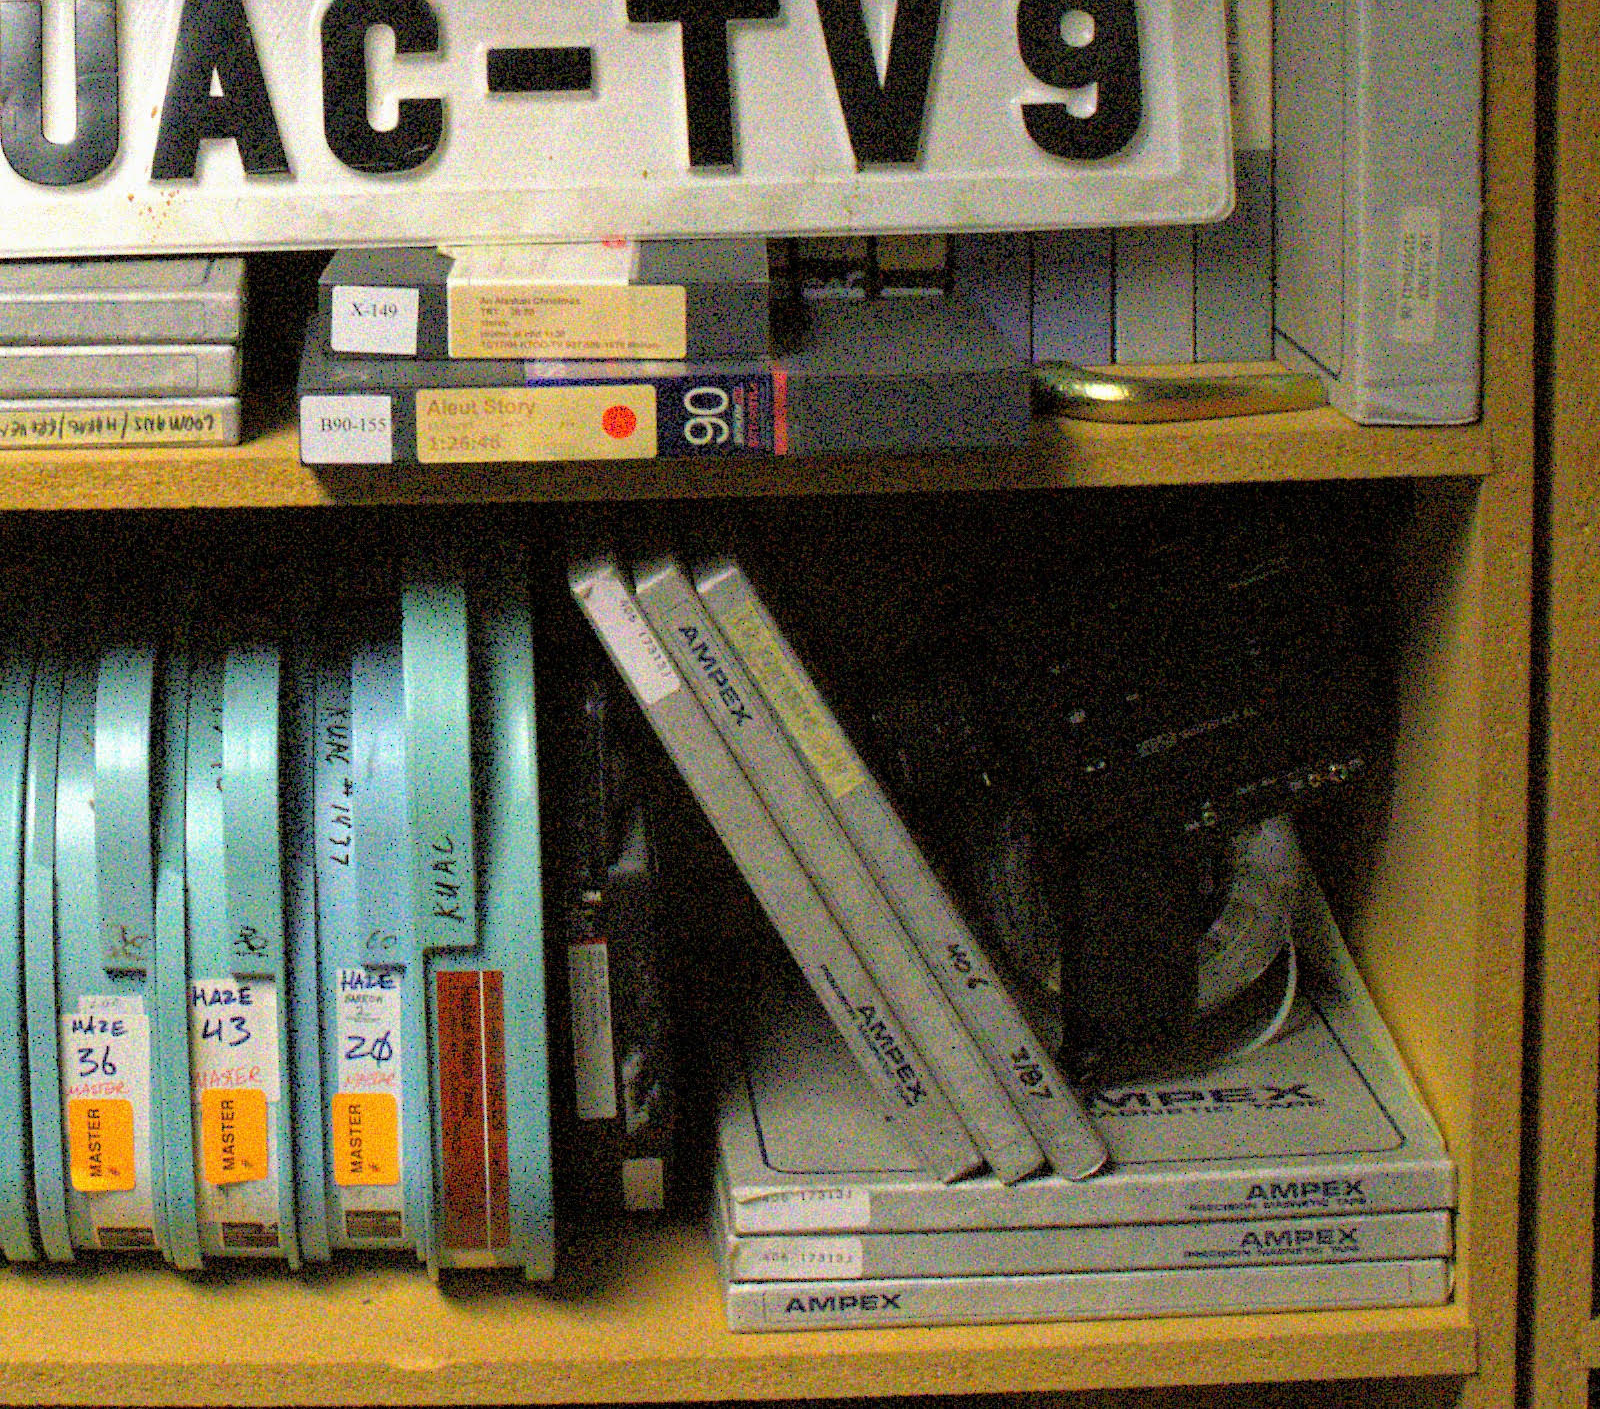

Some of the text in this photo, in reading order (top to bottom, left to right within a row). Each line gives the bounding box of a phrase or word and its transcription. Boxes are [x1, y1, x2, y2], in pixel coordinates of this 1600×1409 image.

[350, 303, 398, 320] X-149
[532, 295, 581, 306] Christmas
[426, 398, 537, 418] Aleut Story
[684, 385, 730, 446] 90
[319, 415, 388, 434] B90-155
[678, 624, 752, 727] AMPEX
[324, 706, 353, 868] KUAC 1437
[432, 835, 465, 922] KUAC
[341, 969, 397, 992] HAZE
[192, 986, 253, 1008] HAZE
[71, 1015, 128, 1037] HAZE
[200, 1017, 251, 1046] 43
[77, 1045, 118, 1077] 36
[857, 1003, 930, 1109] AMPEX
[1084, 1083, 1314, 1109] MPEX
[88, 1107, 102, 1177] MASTER
[223, 1098, 235, 1171] MASTER
[350, 1103, 363, 1174] MASTER
[1246, 1180, 1365, 1201] AMPEX
[1189, 1201, 1258, 1212] PRECISION
[1336, 1196, 1367, 1207] TAPE
[1240, 1227, 1359, 1248] AMPEX
[1183, 1248, 1252, 1259] PRECISION
[1331, 1244, 1360, 1254] TAPE
[785, 1293, 902, 1314] AMPEX
